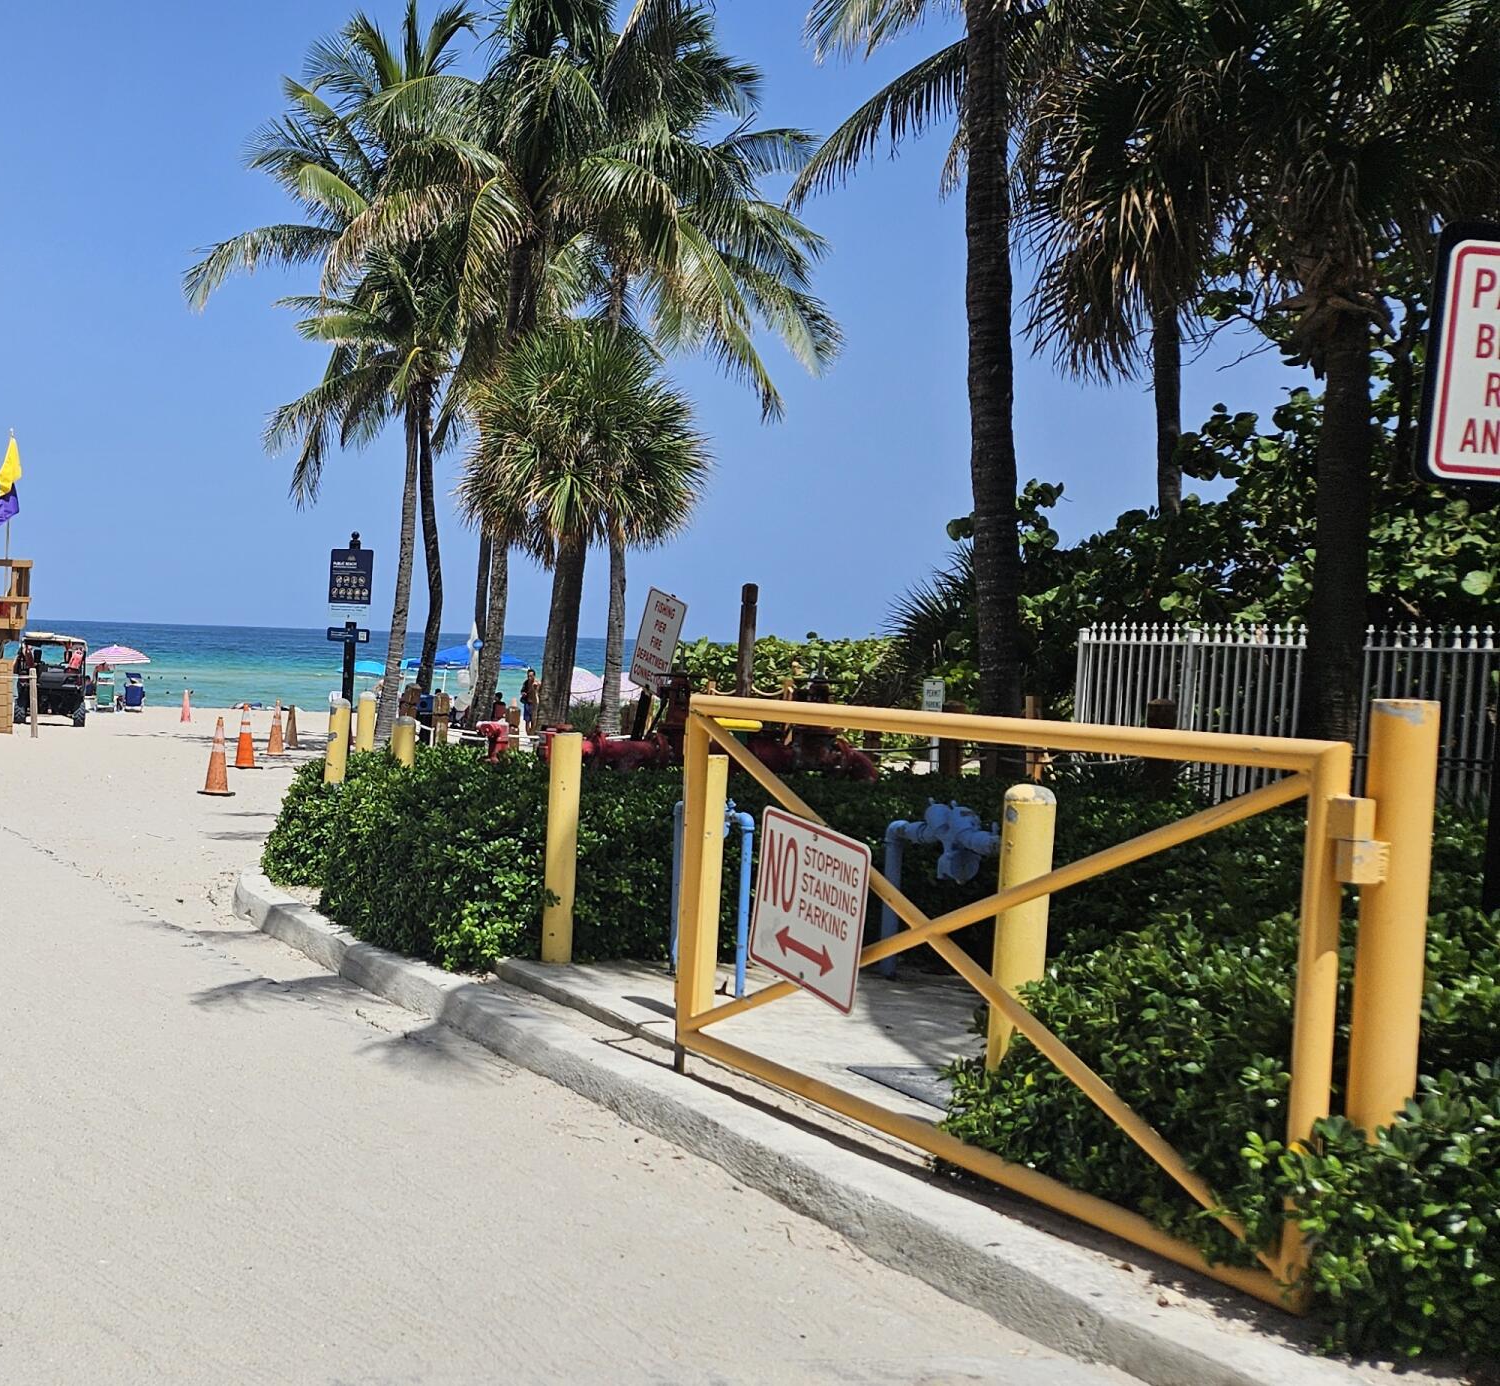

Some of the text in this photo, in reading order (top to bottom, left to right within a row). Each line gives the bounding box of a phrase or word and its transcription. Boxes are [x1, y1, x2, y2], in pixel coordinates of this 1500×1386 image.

[1472, 267, 1500, 309] P
[1475, 323, 1500, 360] B
[654, 619, 667, 633] PIER
[655, 600, 676, 619] FISHING
[636, 647, 669, 673] DEPARTMENT
[650, 635, 663, 651] FIRE
[763, 829, 799, 913] NO
[803, 846, 859, 889] STOPPING
[801, 873, 857, 917] STANDING
[798, 898, 848, 942] PARKING
